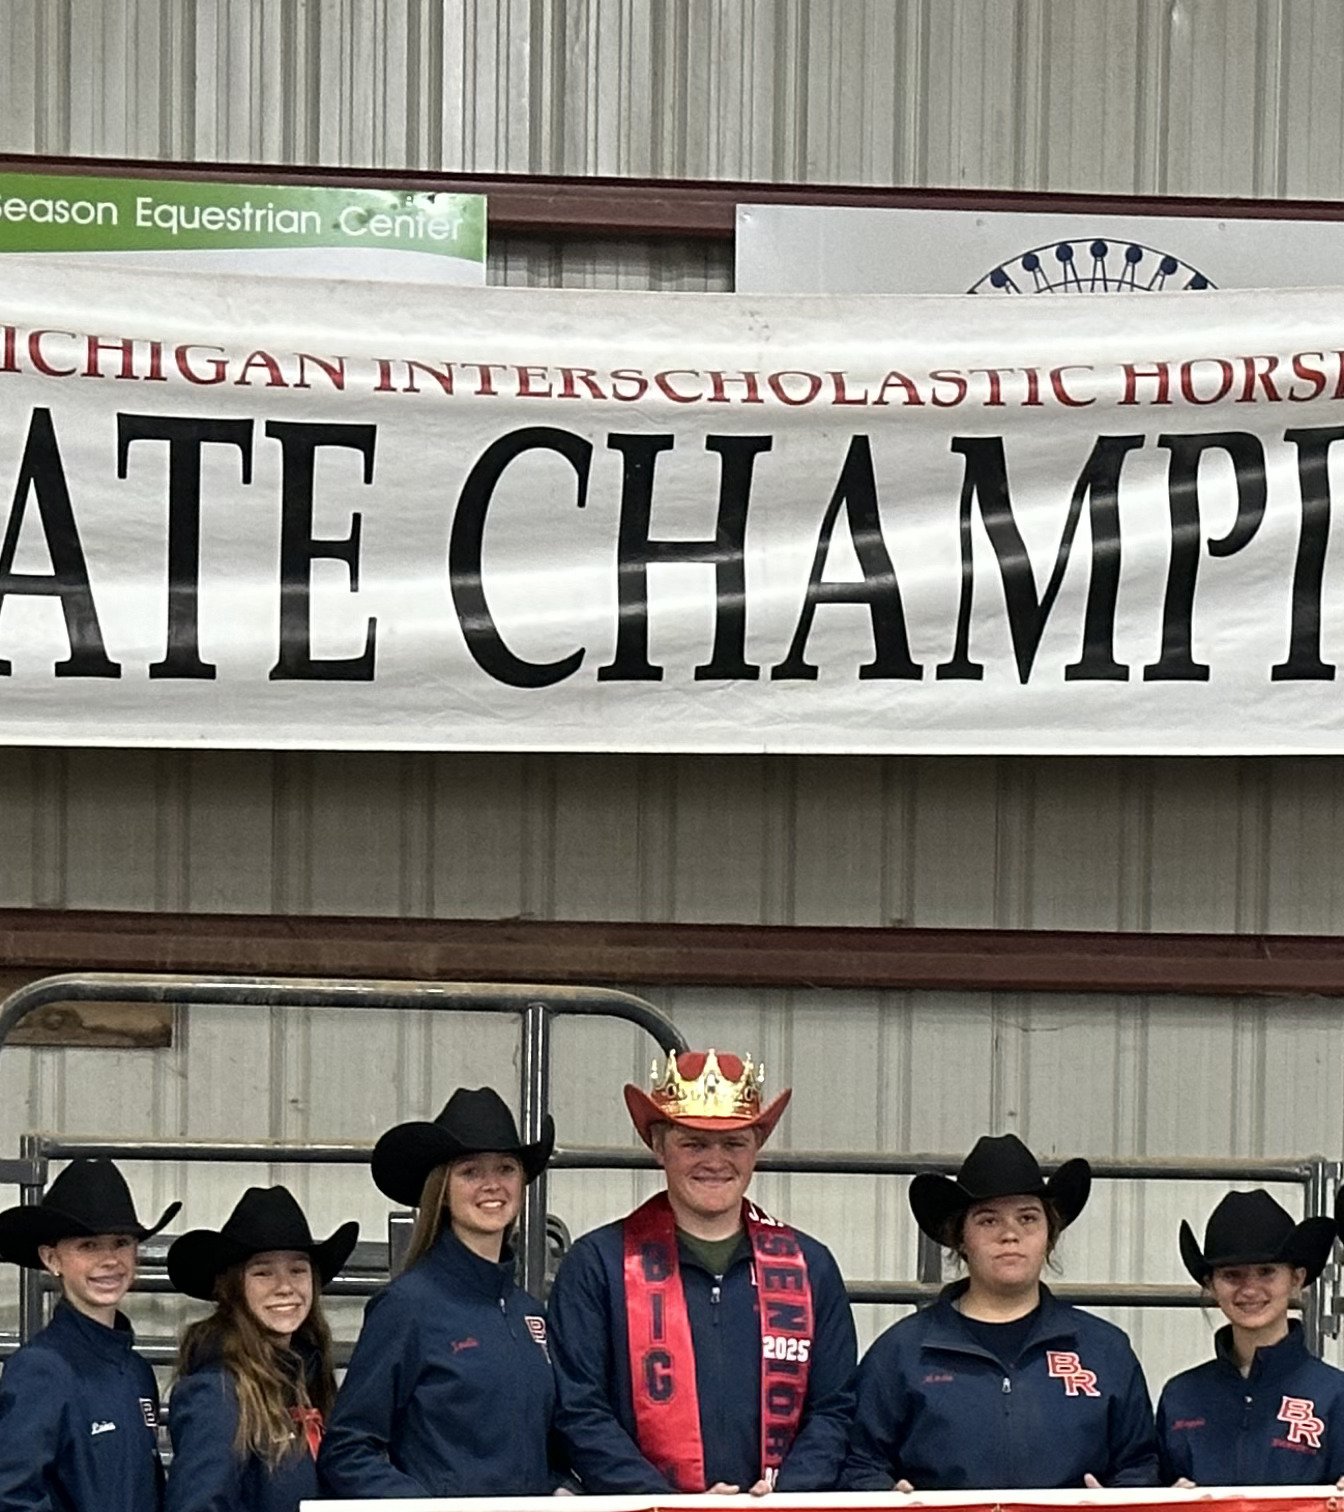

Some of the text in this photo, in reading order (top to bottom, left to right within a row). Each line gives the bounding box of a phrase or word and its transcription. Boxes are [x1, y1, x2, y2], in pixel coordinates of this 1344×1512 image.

[136, 197, 321, 235] Equestrian
[340, 205, 464, 241] Center
[374, 356, 1097, 407] INTERSCHOLASTIC
[640, 1240, 675, 1404] BIG
[762, 1335, 811, 1362] 2025
[1046, 1350, 1101, 1397] BR
[1277, 1395, 1324, 1448] BR
